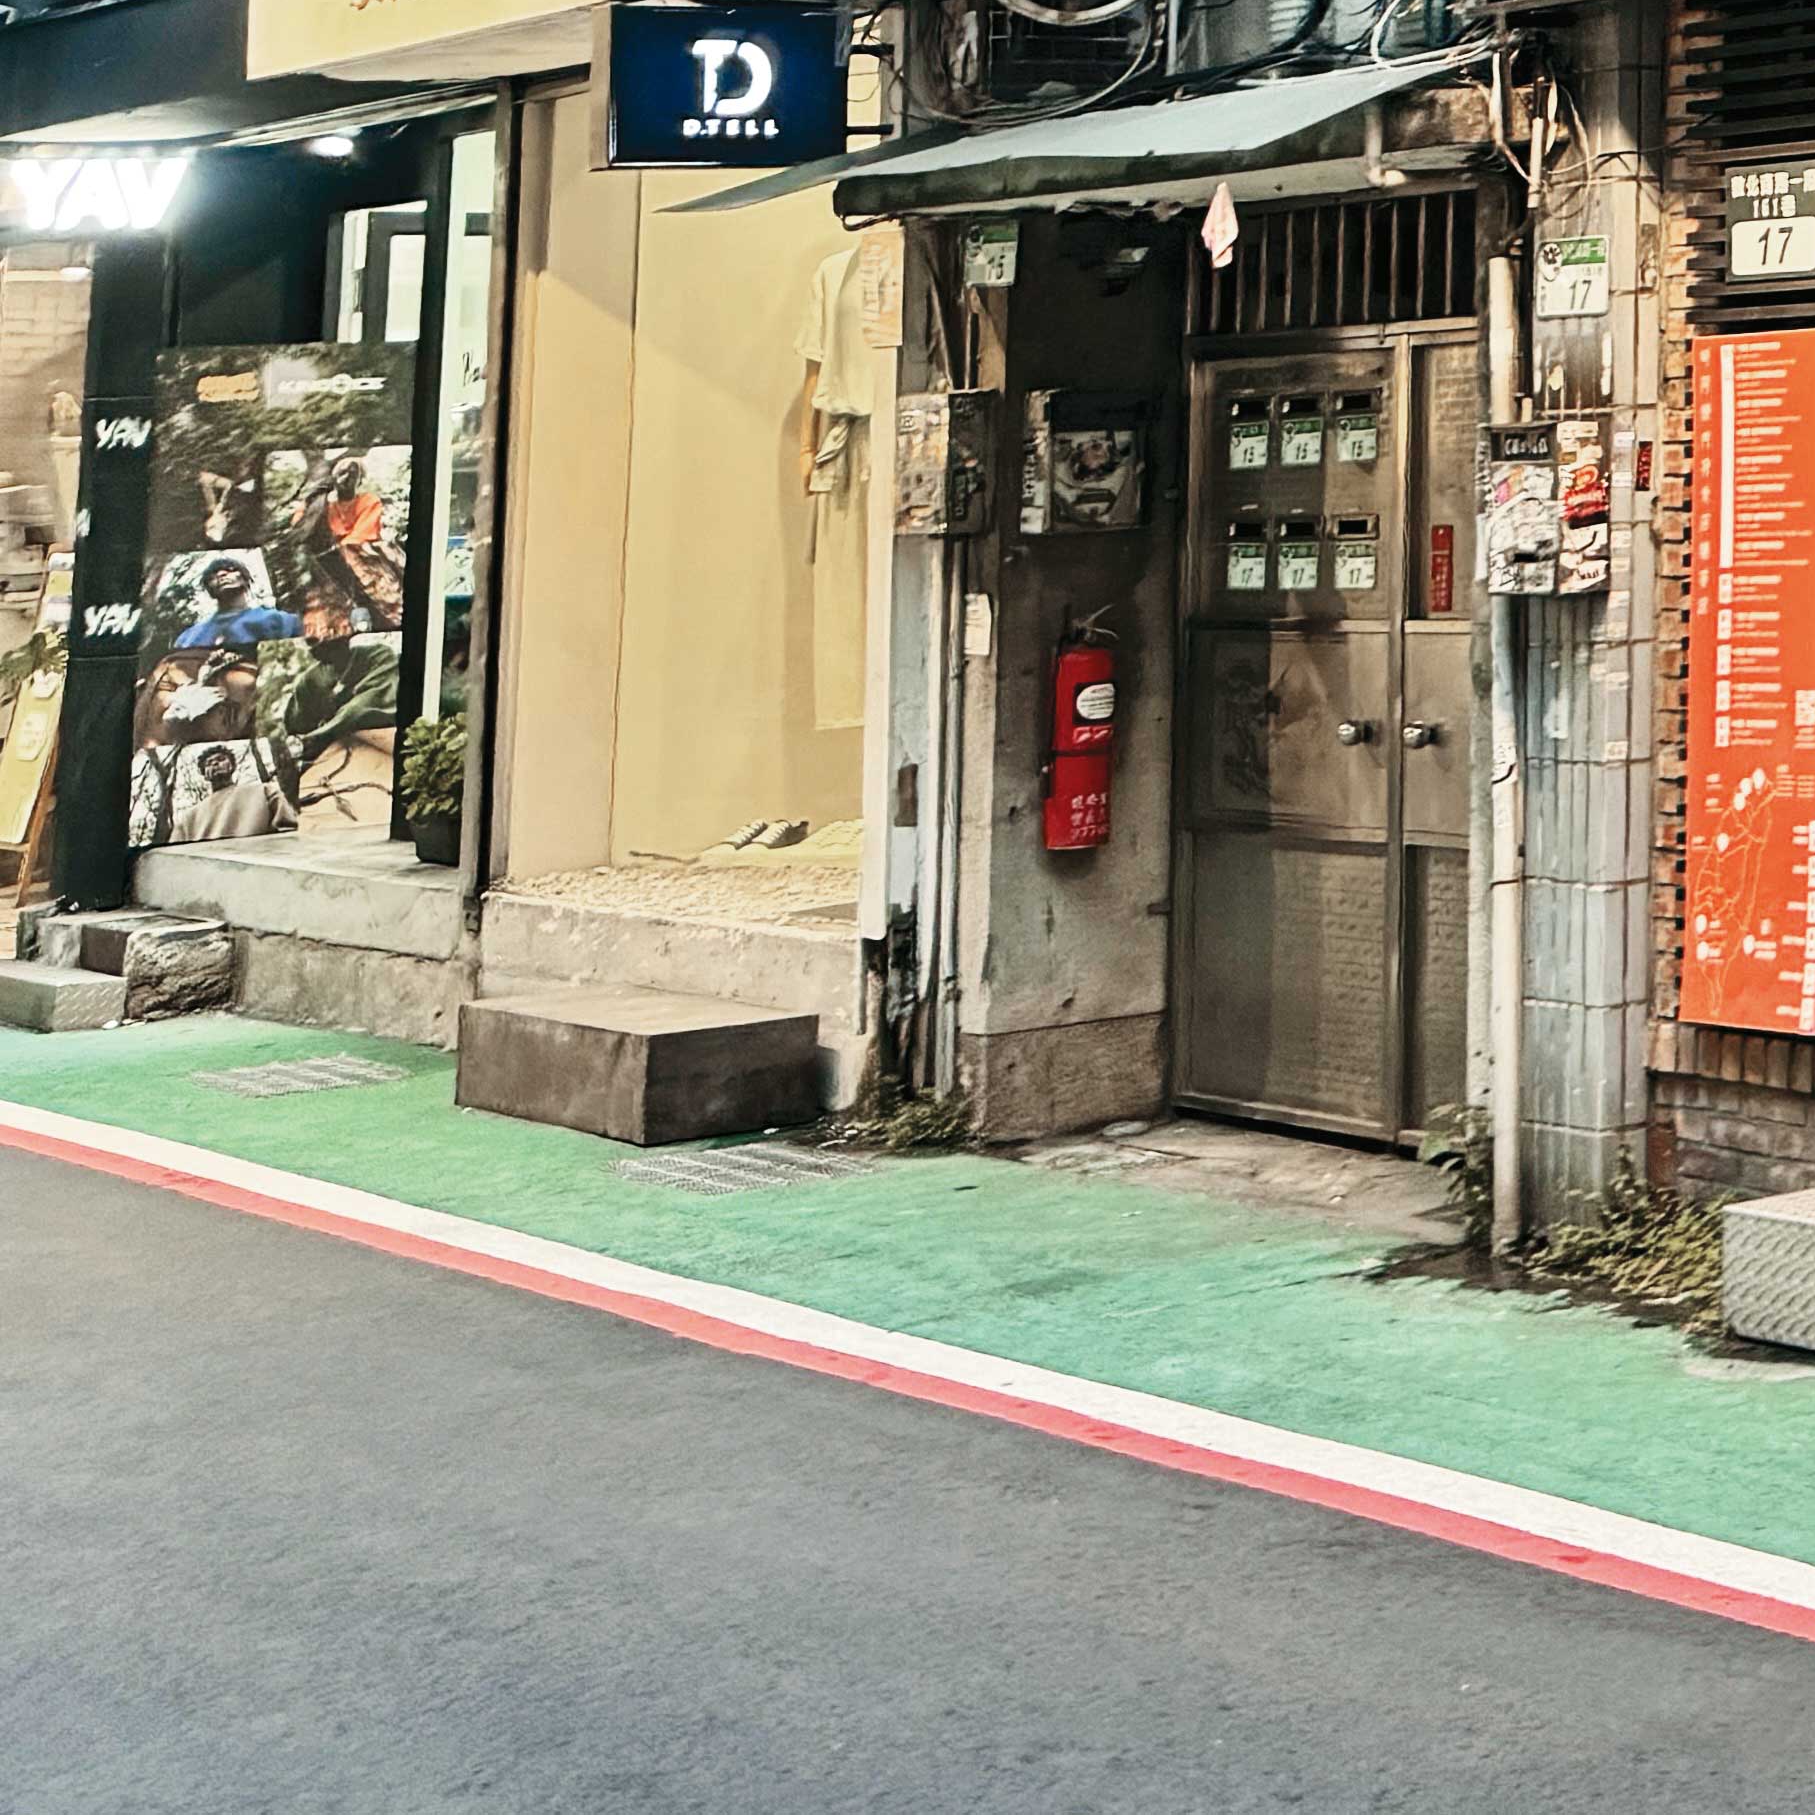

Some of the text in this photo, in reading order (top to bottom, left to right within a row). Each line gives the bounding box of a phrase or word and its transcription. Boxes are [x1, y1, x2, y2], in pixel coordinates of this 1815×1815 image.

[683, 118, 779, 137] D.TELL
[10, 157, 188, 231] YAV
[1759, 226, 1794, 266] 17
[1568, 279, 1593, 311] 17
